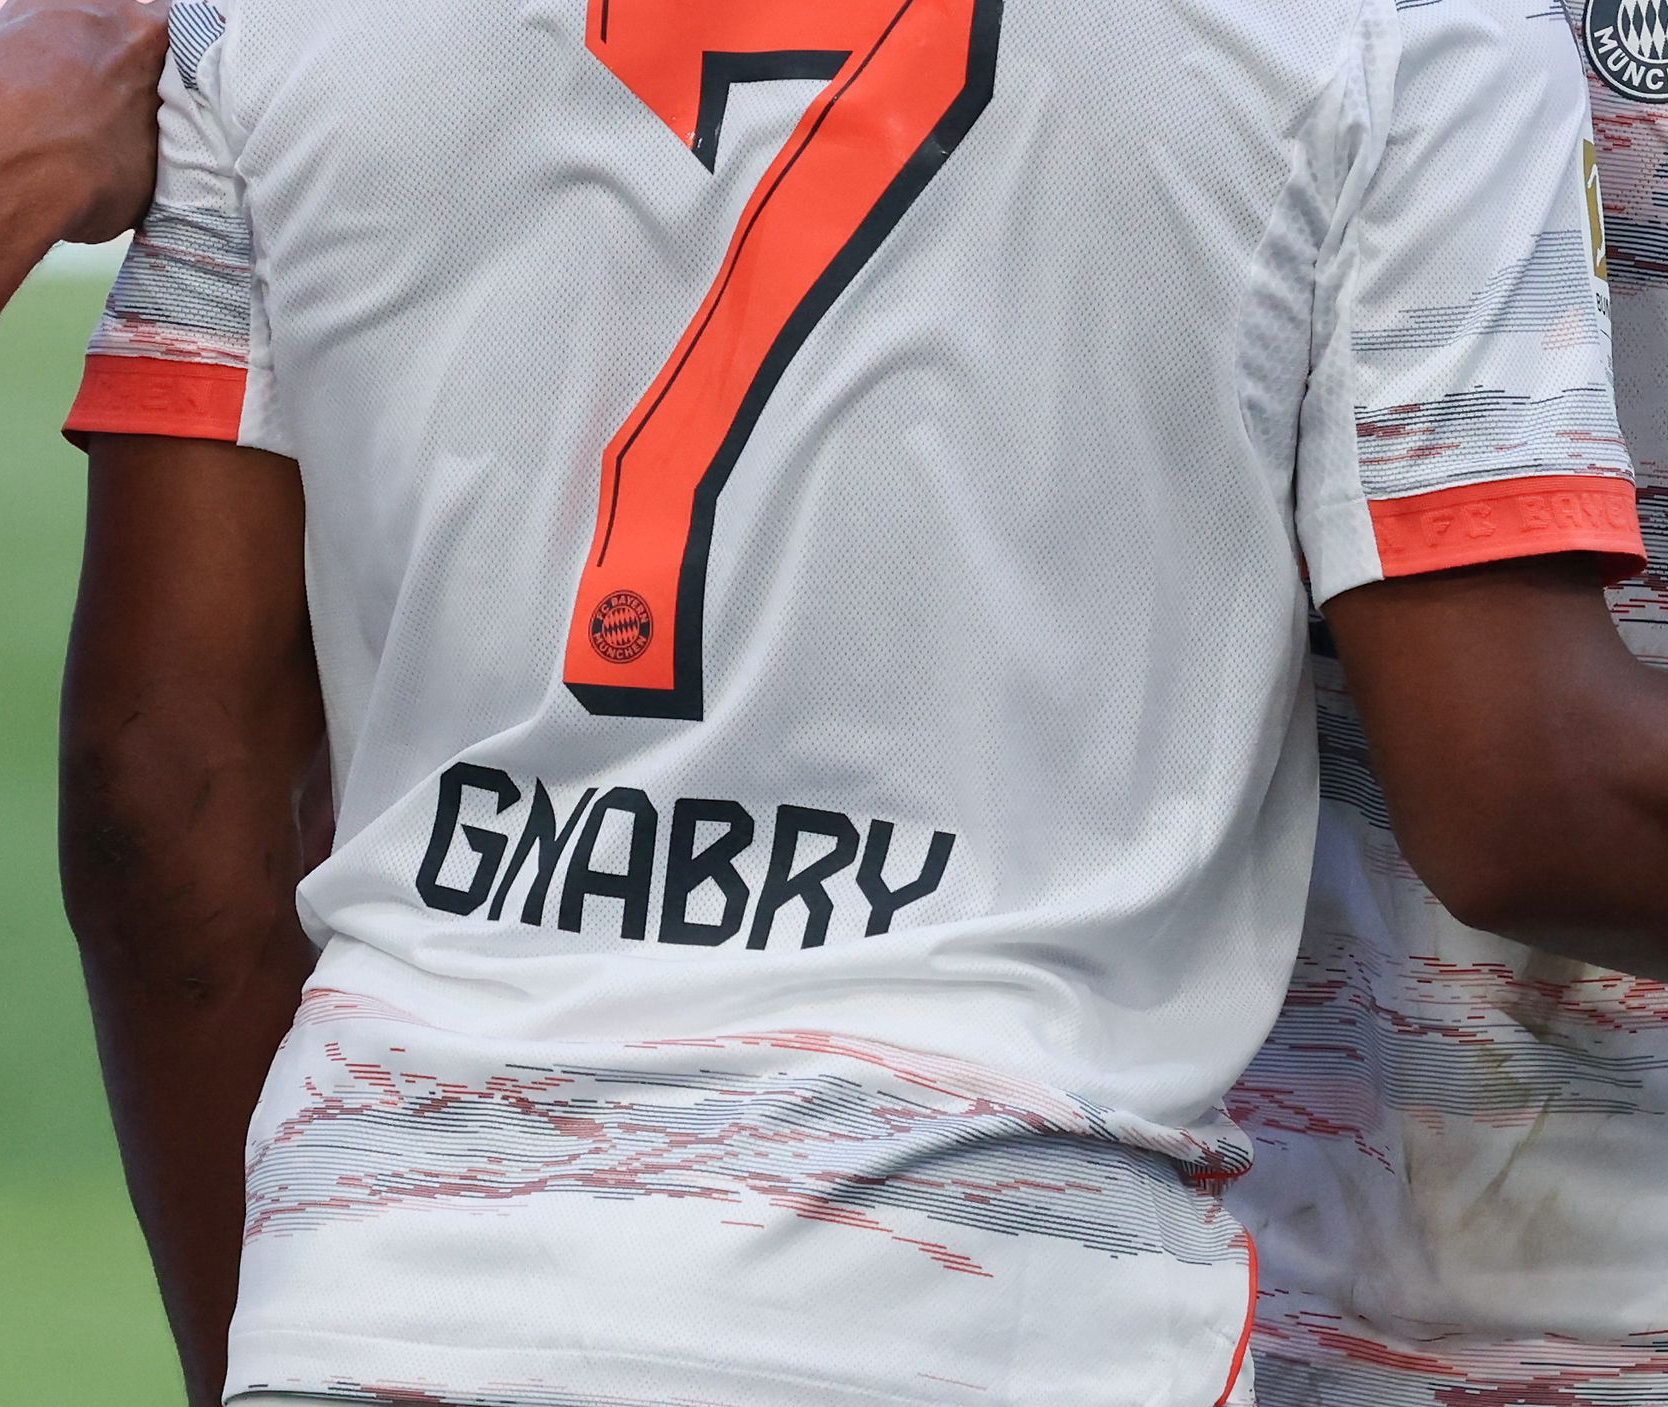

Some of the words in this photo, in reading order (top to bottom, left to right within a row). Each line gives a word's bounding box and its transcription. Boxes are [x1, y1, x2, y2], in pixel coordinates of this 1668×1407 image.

[596, 603, 610, 621] FC
[611, 595, 649, 623] BAYERN
[415, 762, 956, 951] GNABRY
